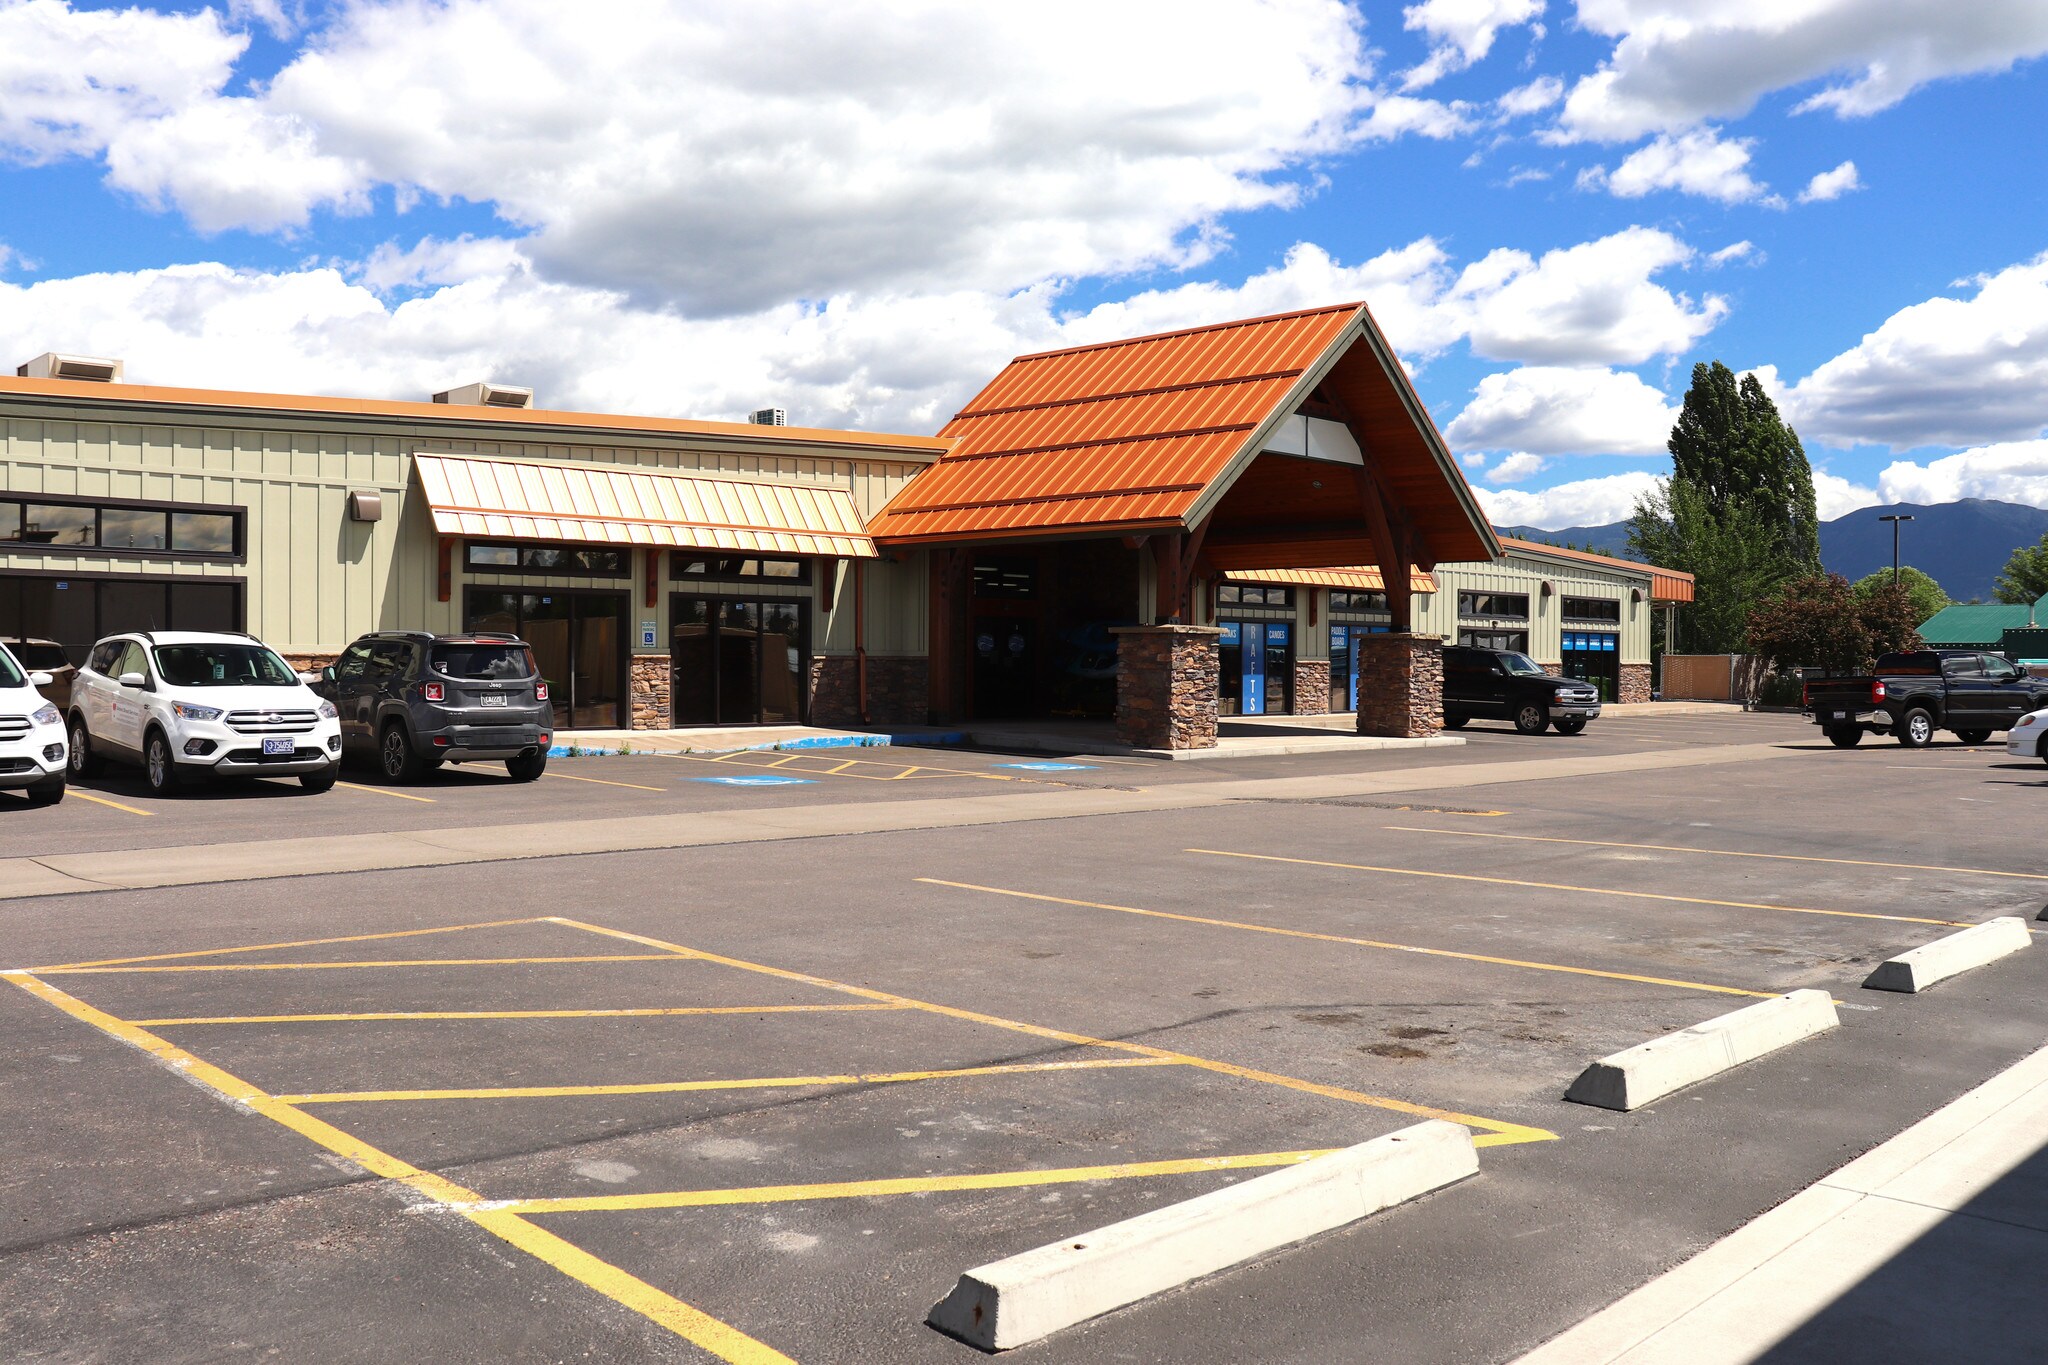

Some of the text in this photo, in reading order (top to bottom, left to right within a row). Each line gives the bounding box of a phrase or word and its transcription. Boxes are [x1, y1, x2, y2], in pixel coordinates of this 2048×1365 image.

[1268, 630, 1285, 639] CANOES
[1331, 626, 1346, 635] PADDLE
[1331, 636, 1345, 646] BOARD
